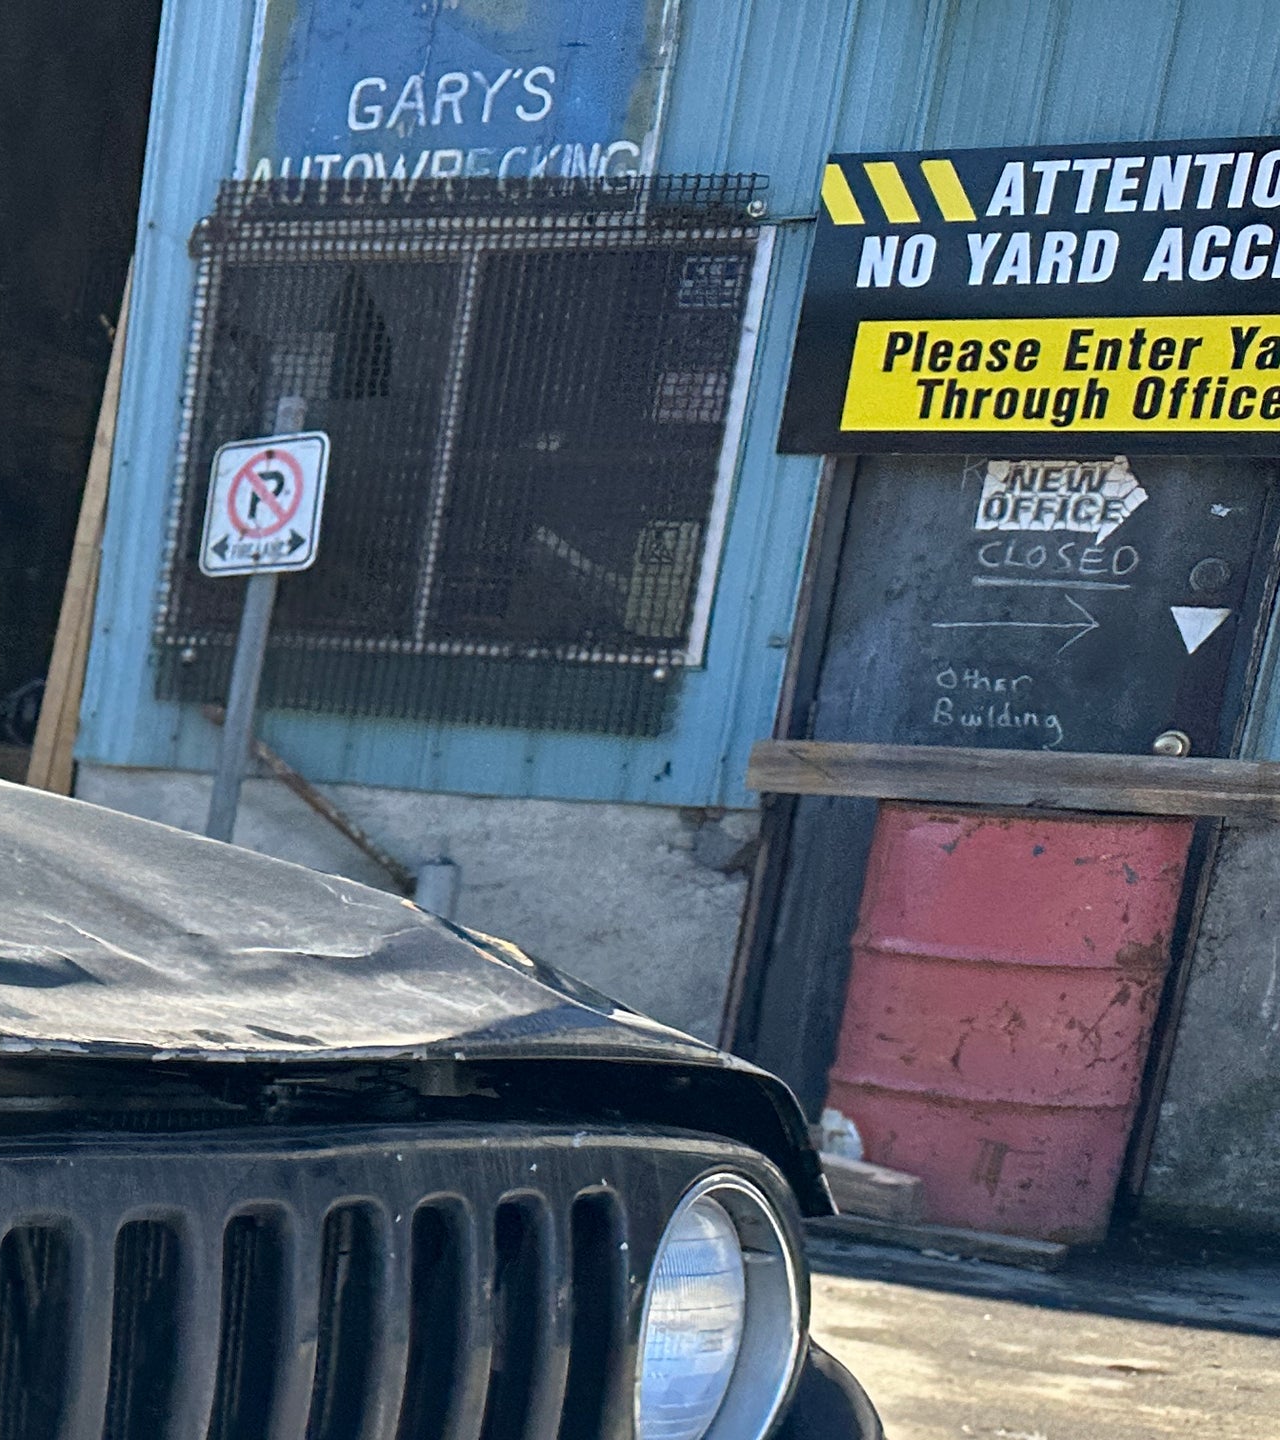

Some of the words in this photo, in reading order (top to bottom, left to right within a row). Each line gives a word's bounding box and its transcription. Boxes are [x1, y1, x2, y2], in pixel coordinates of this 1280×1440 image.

[347, 65, 556, 132] GARY'S
[855, 232, 938, 289] NO
[966, 228, 1120, 286] YARD
[1142, 223, 1280, 283] ACC
[882, 331, 1041, 372] Please
[1064, 328, 1203, 371] Enter
[917, 378, 1111, 428] Through
[1003, 464, 1110, 493] NEW
[982, 492, 1127, 523] OFFICE
